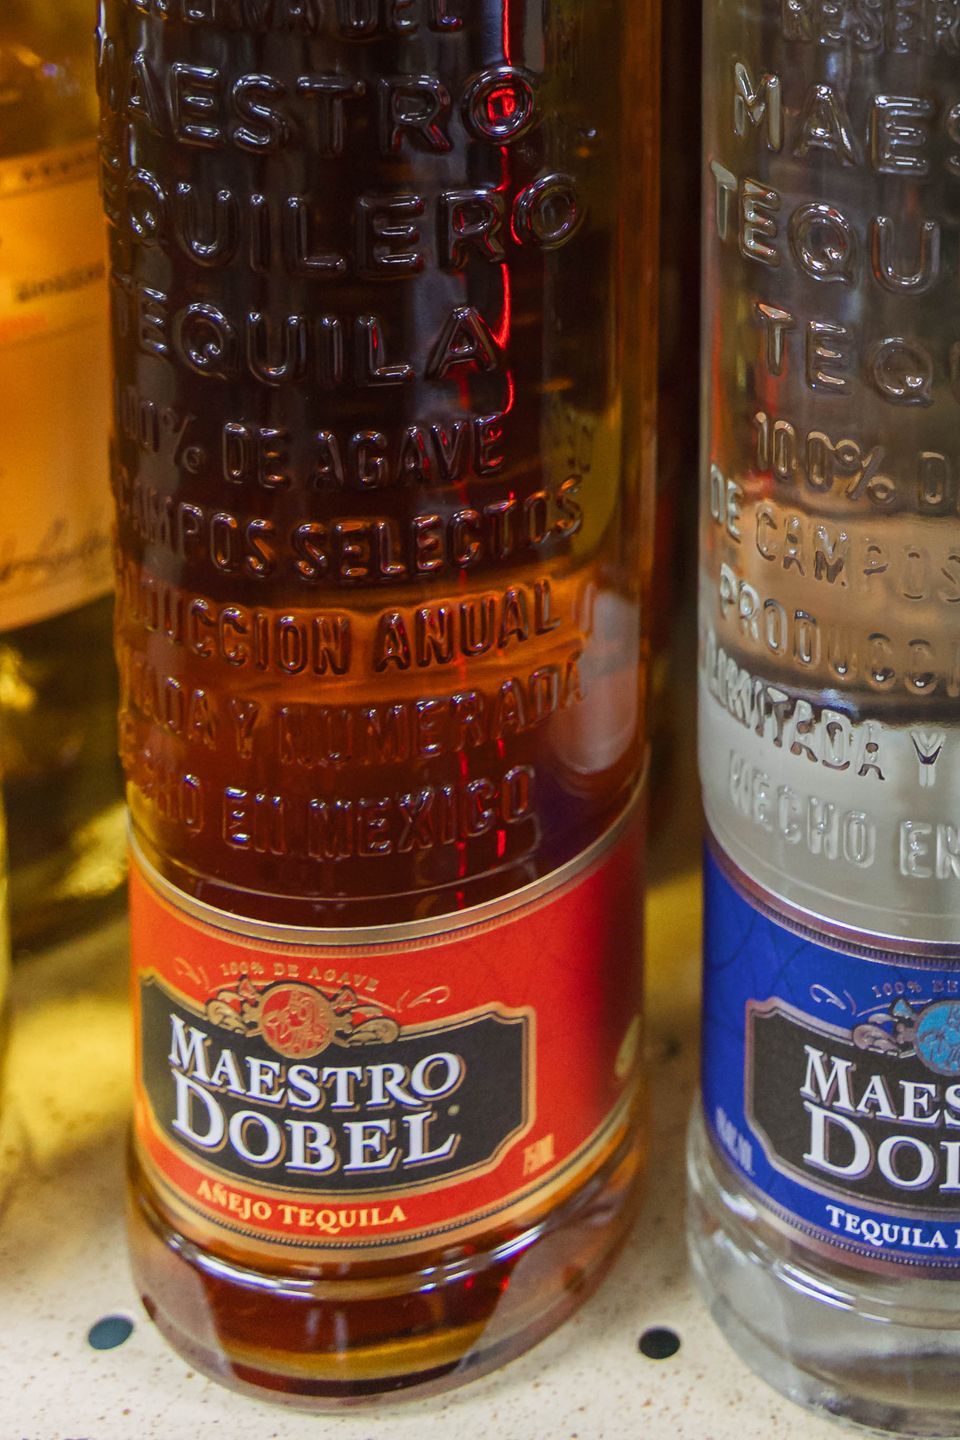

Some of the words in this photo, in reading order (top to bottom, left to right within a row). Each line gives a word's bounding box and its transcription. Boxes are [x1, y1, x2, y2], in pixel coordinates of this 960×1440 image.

[104, 48, 539, 154] AESTRO
[106, 162, 584, 278] QUILERO
[221, 421, 291, 489] DE
[311, 412, 504, 493] AGAVE
[752, 410, 898, 507] 100%
[294, 474, 585, 581] SELECTOS
[708, 462, 744, 544] DE
[371, 577, 561, 674] ANUAL
[230, 697, 264, 760] Y
[910, 729, 949, 788] Y
[222, 786, 287, 857] EN
[306, 764, 537, 863] MEXICO
[728, 748, 877, 869] HECHO
[219, 960, 266, 977] 100%
[273, 962, 300, 978] DE
[308, 966, 381, 993] AGAVE
[871, 979, 923, 998] 100%
[168, 1012, 466, 1111] MAESTRO
[169, 1068, 460, 1176] DOBEL
[197, 1179, 273, 1224] AÑEJO
[282, 1203, 408, 1236] TEQUILA
[825, 1203, 947, 1251] TEQUILA
